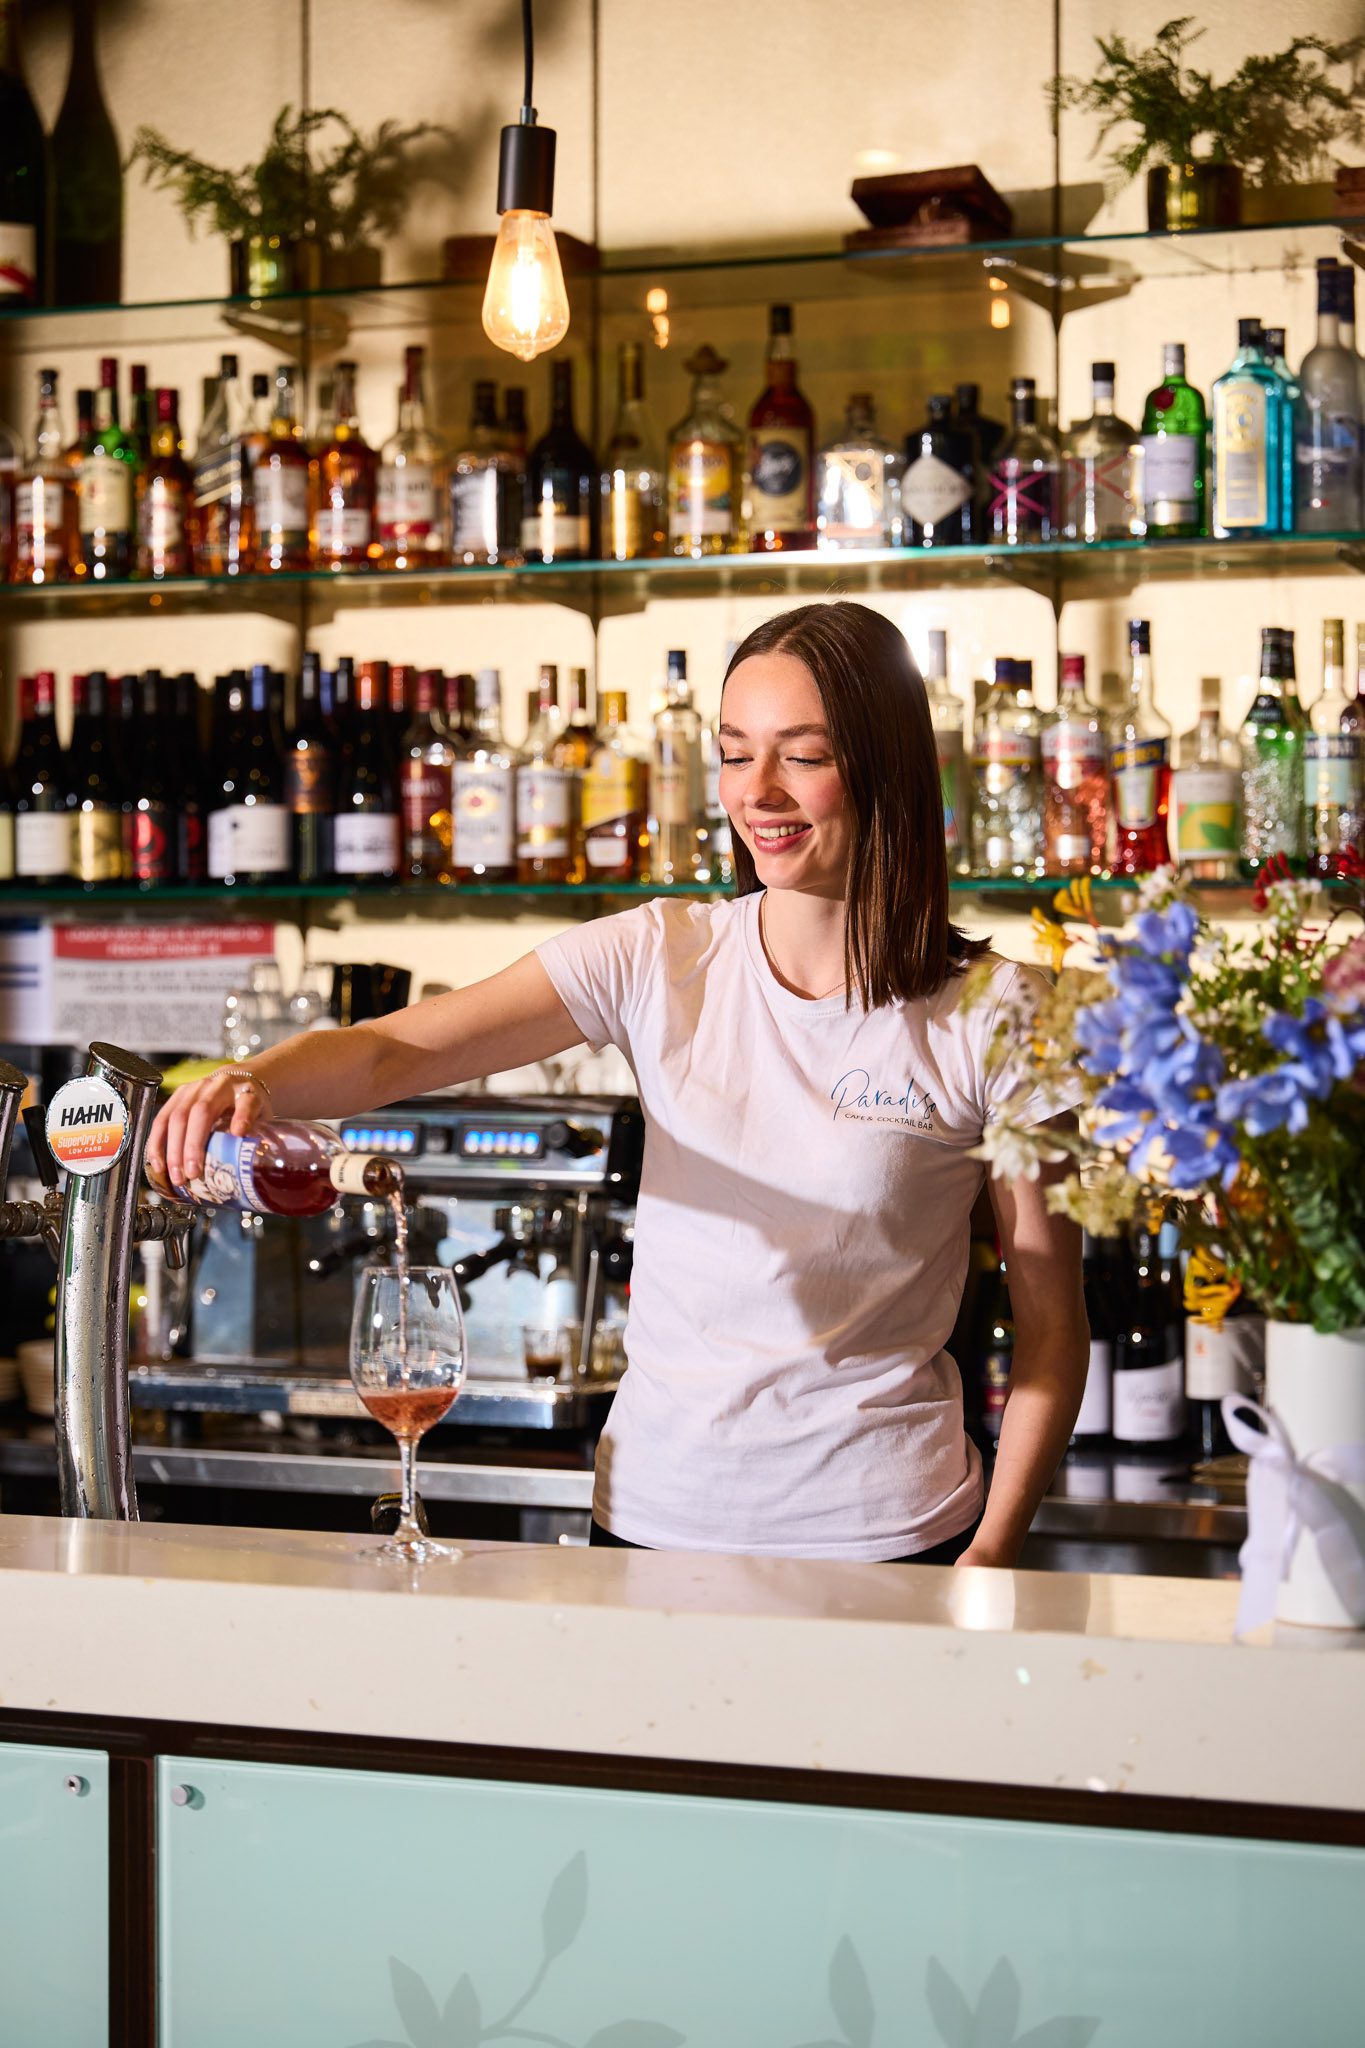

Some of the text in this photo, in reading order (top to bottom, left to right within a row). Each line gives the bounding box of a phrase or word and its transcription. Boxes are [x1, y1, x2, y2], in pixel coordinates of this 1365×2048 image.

[831, 1069, 936, 1120] Paradiso
[61, 1103, 114, 1127] HAHN
[876, 1116, 916, 1128] COCKTAIL
[917, 1121, 934, 1131] BAR
[58, 1134, 96, 1149] SuperDry
[84, 1145, 102, 1153] CARB
